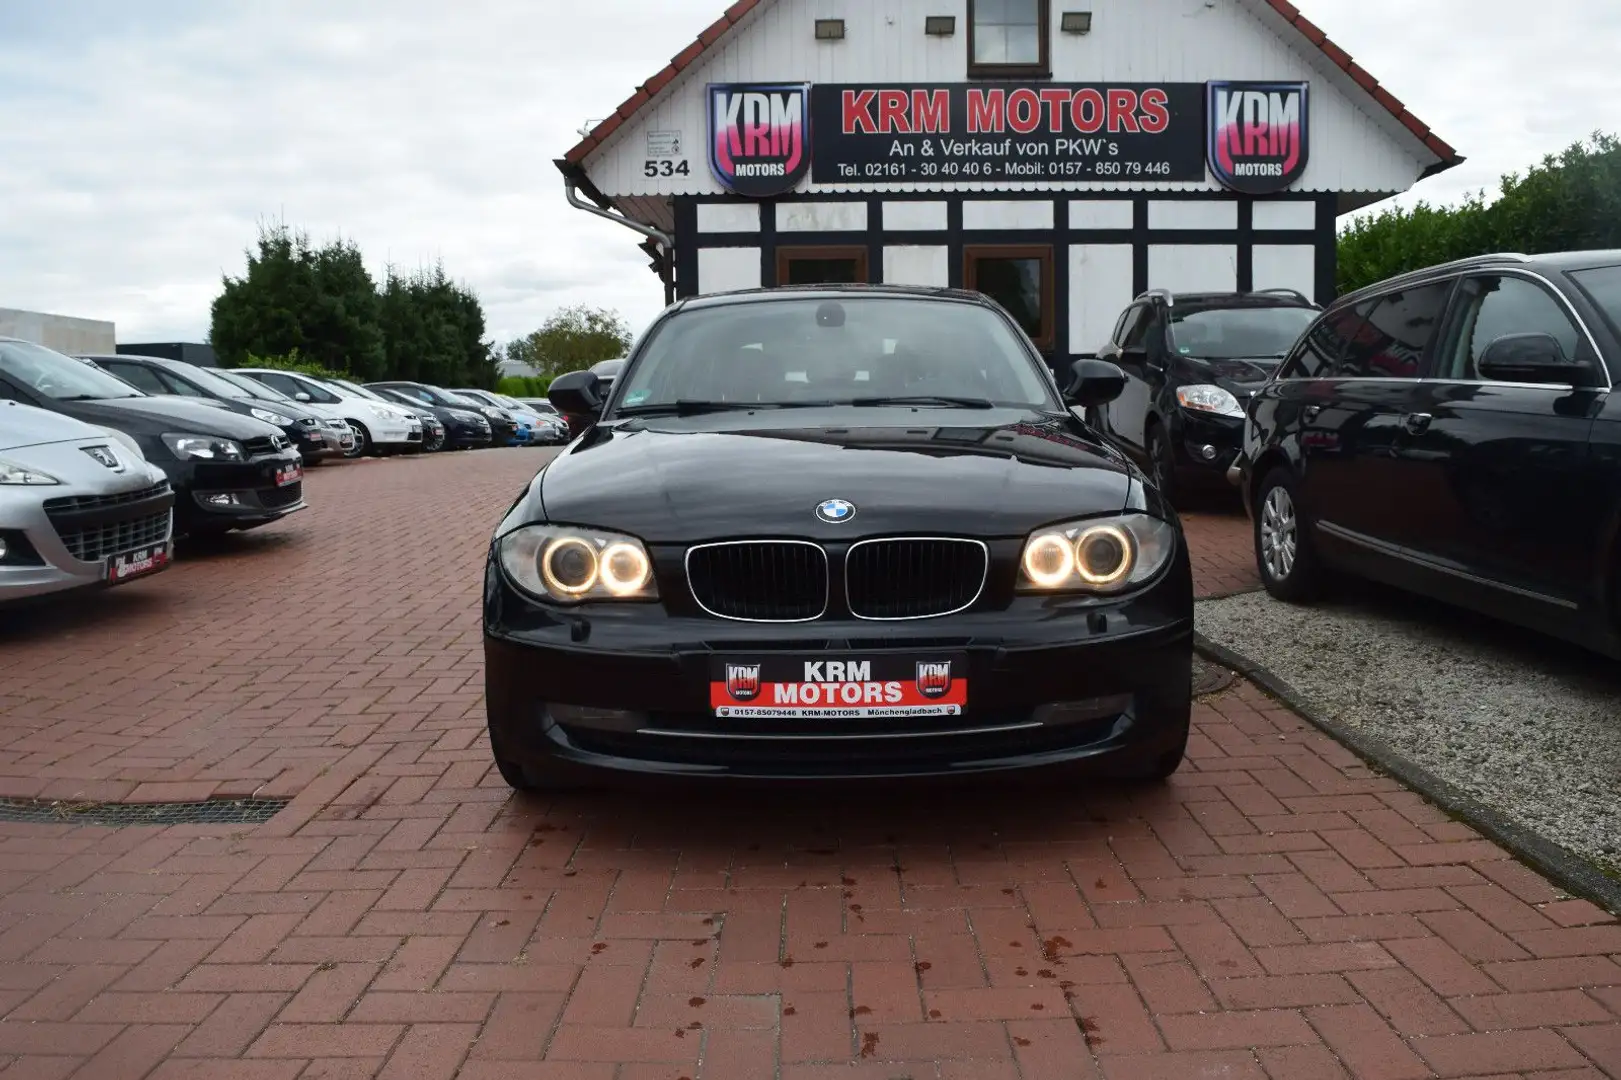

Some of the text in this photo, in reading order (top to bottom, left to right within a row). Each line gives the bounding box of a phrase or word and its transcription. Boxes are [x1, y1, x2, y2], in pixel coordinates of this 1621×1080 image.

[842, 88, 1169, 134] KRM MOTORS
[717, 92, 802, 174] KRM
[1217, 91, 1299, 175] KRM
[889, 139, 914, 157] An
[920, 139, 934, 157] &
[940, 138, 1011, 157] Verkauf
[1016, 143, 1048, 156] von
[644, 160, 690, 177] 534
[736, 163, 785, 176] MOTORS
[837, 163, 861, 176] Tel.
[865, 163, 906, 176] 02161
[920, 163, 938, 175] 30
[941, 162, 959, 175] 40
[962, 162, 979, 175] 40
[982, 162, 992, 175] 6
[1005, 161, 1045, 175] Mobil:
[1049, 162, 1082, 175] 0157
[1095, 162, 1121, 175] 850
[1124, 162, 1141, 175] 79
[1144, 161, 1170, 175] 446
[1235, 163, 1282, 176] MOTORS
[804, 660, 871, 682] KRM
[774, 681, 903, 704] MOTORS
[801, 709, 860, 717] KRM-MOTORS
